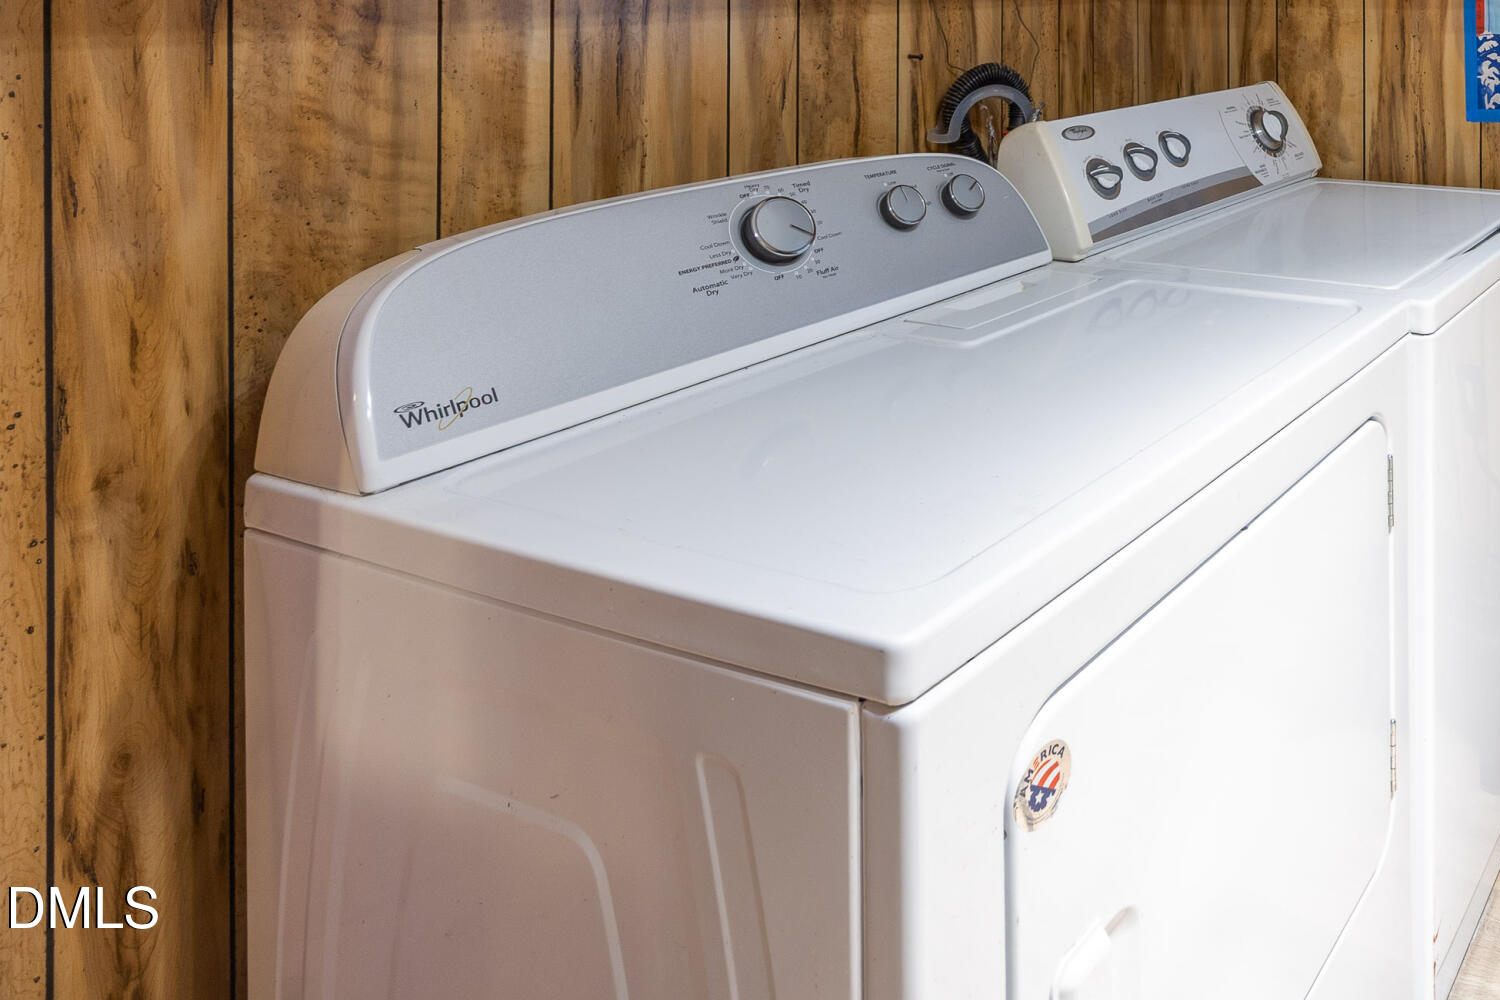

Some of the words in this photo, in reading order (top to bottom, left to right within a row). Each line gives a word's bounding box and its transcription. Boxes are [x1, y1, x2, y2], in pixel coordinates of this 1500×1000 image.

[864, 169, 897, 180] TEMPERATURE
[792, 180, 811, 189] Timed
[713, 240, 731, 248] Down
[678, 266, 700, 276] ENERGY
[701, 259, 732, 270] PREFERRED
[720, 266, 734, 274] More
[816, 268, 830, 276] Fluff
[692, 279, 729, 294] Automatic
[706, 289, 720, 297] Dry
[399, 387, 499, 429] Whirlpool
